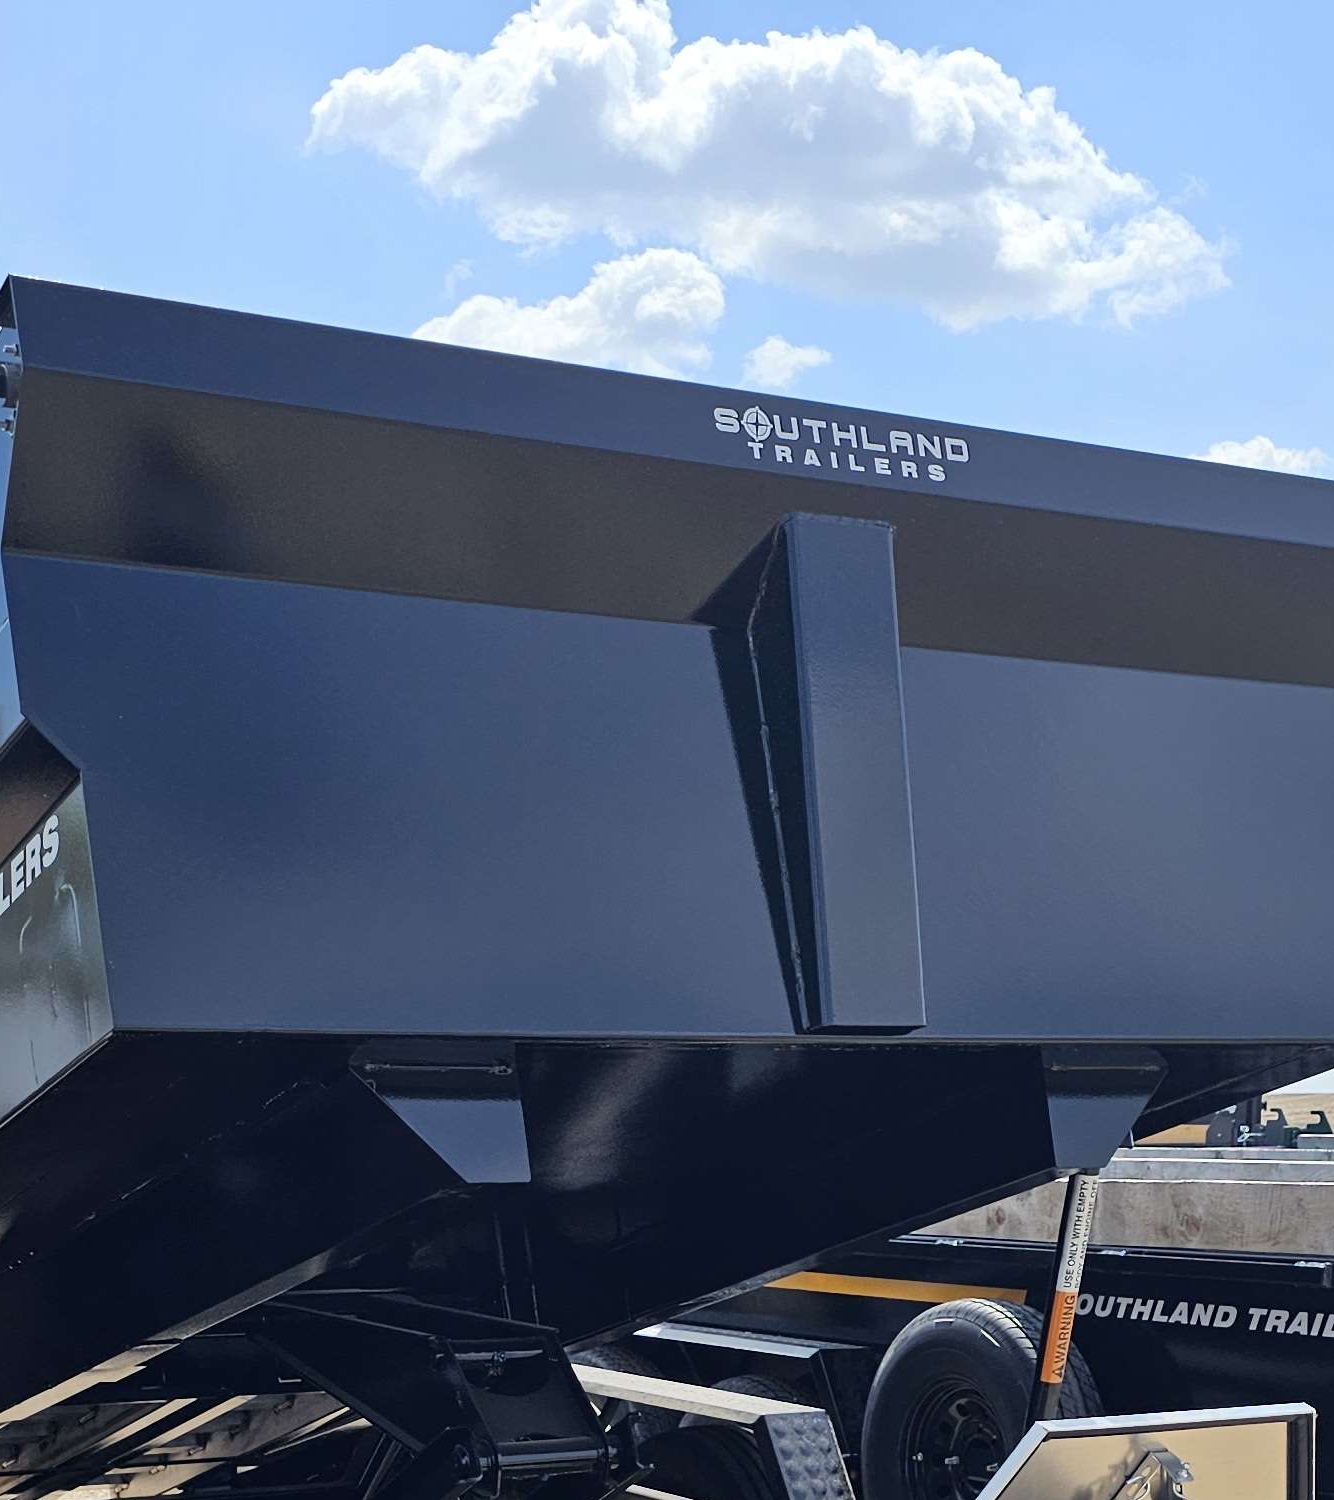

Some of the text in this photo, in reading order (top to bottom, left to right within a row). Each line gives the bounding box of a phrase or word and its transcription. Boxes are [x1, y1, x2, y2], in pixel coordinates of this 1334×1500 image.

[713, 406, 970, 463] SOUTHLAND
[747, 441, 946, 482] TRAILERS
[1064, 1179, 1089, 1288] USE ONLY WITH EMPTY
[1056, 1295, 1075, 1364] WARNING
[1075, 1293, 1237, 1329] OUTHLAND
